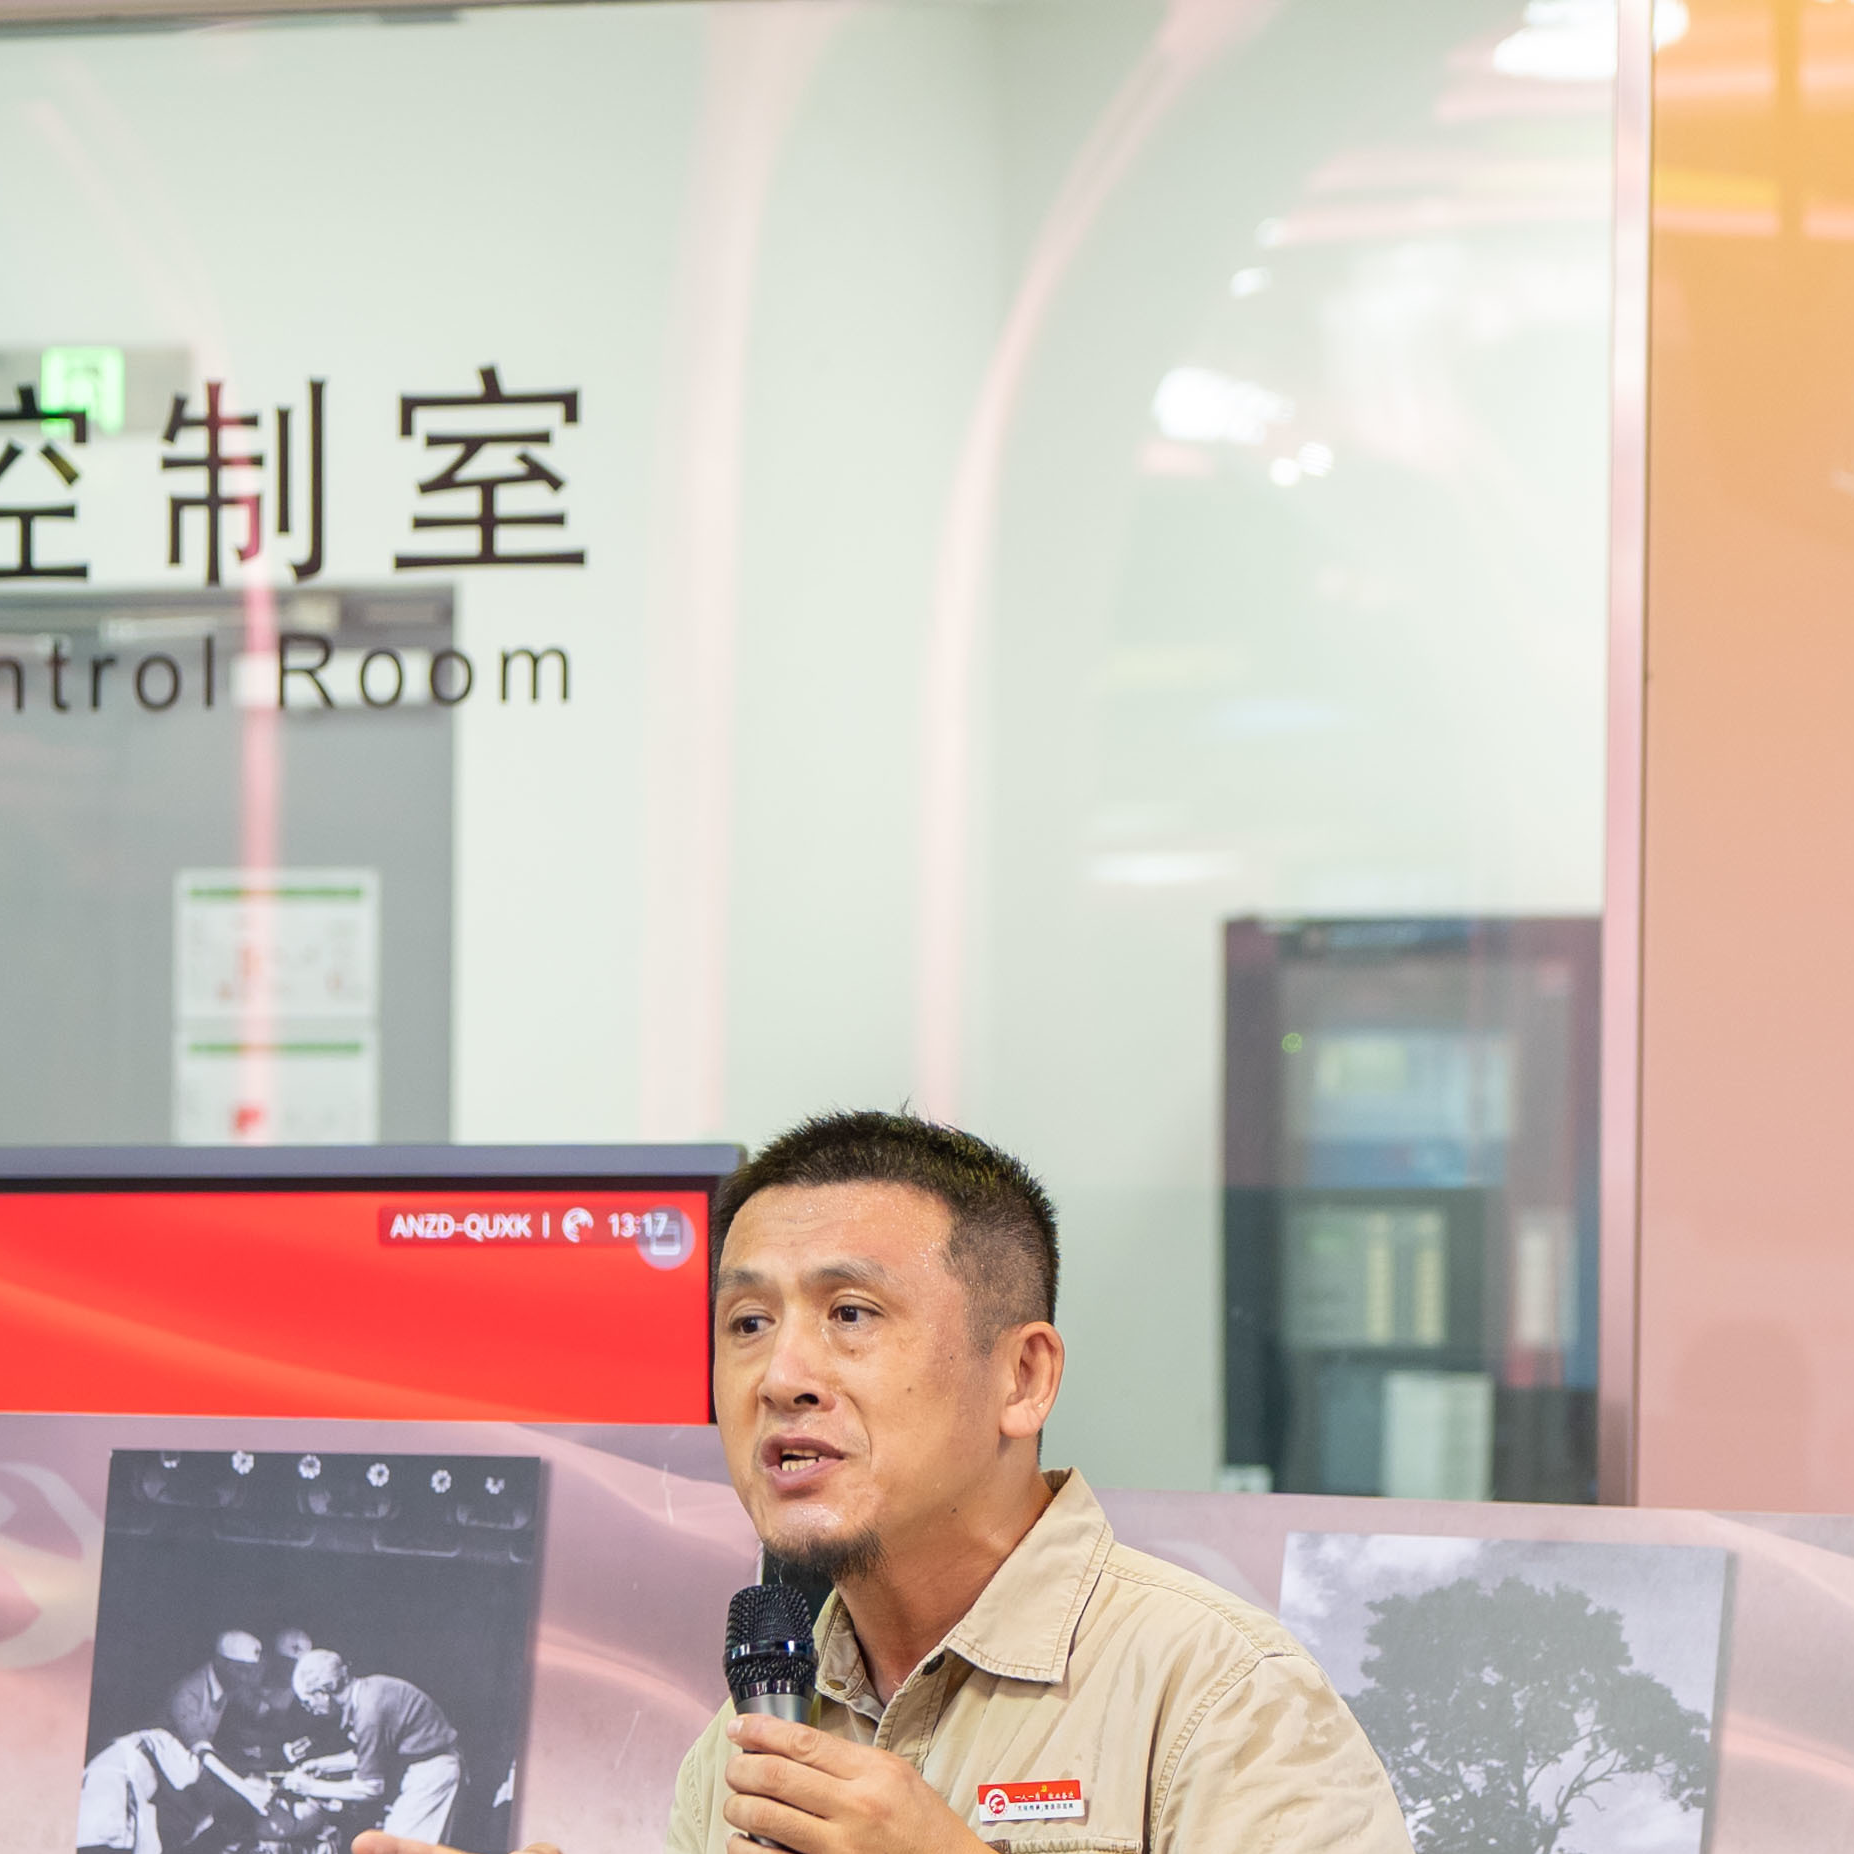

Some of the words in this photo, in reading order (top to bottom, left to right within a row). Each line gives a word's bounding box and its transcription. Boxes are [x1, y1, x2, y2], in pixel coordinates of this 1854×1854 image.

[278, 631, 572, 710] Room
[390, 1212, 532, 1242] ANZD-QUXK
[608, 1212, 669, 1239] 13:17
